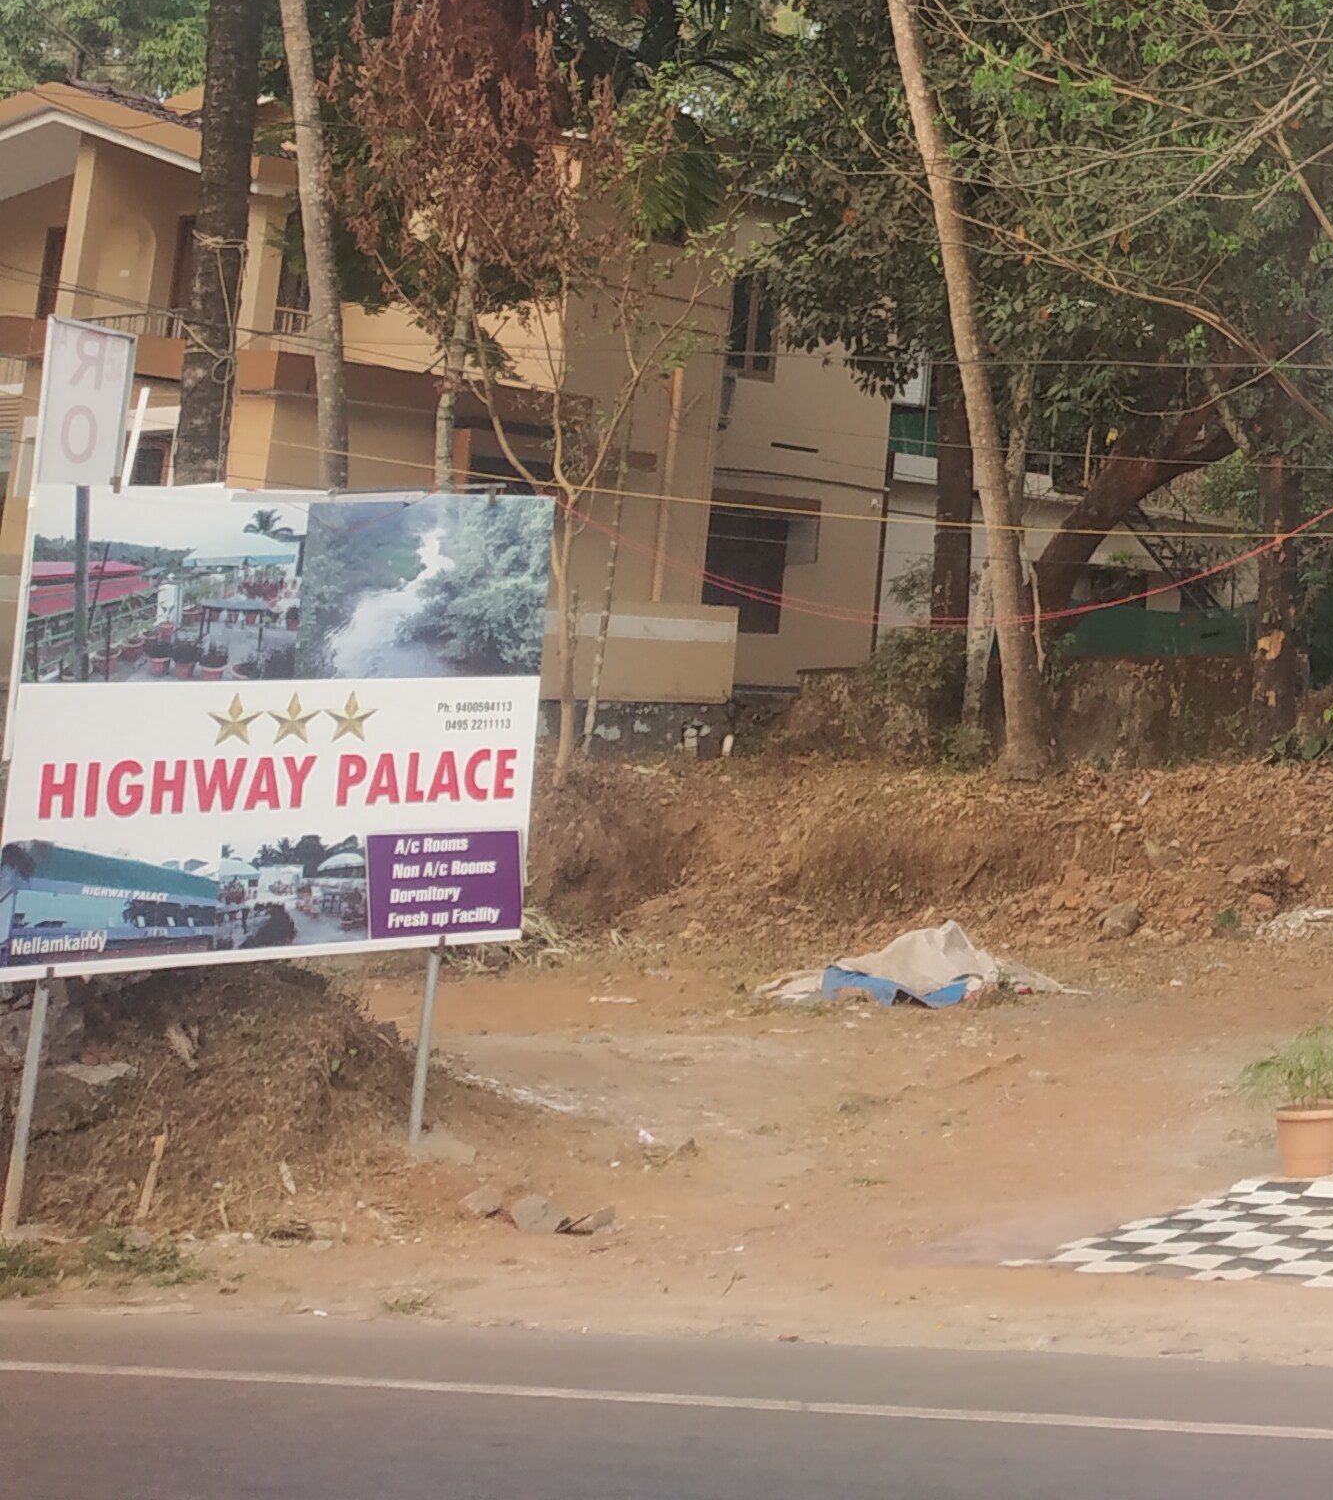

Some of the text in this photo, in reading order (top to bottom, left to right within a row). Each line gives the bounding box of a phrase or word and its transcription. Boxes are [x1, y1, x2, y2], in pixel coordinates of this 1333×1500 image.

[437, 701, 512, 714] Ph: 9400594113
[445, 718, 511, 731] 0495 2211113
[38, 748, 518, 819] HIGHWAY PALACE
[394, 837, 469, 856] A/c Rooms
[392, 860, 497, 879] Non A/c Rooms
[82, 885, 169, 902] HIGHWAY PALACE
[389, 886, 461, 904] Dormitory
[387, 906, 501, 929] Fresh up Facility
[11, 929, 107, 956] Nellamkandy
